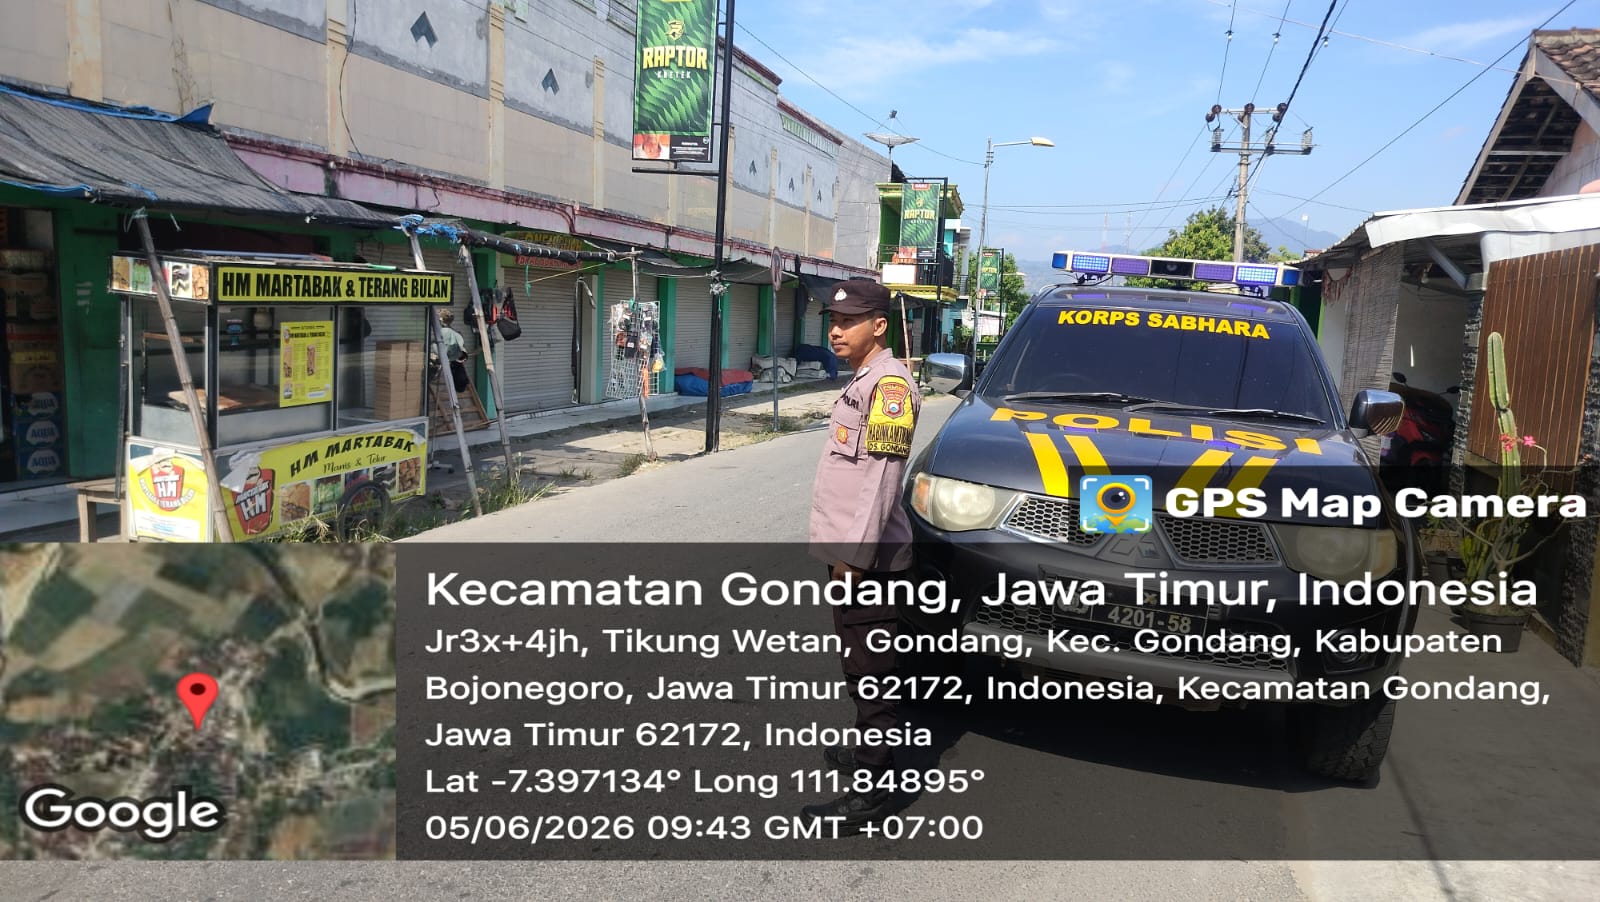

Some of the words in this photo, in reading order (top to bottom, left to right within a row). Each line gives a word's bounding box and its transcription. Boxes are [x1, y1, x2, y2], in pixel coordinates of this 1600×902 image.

[642, 45, 708, 71] RAPTOR
[222, 271, 251, 297] HM
[256, 273, 342, 298] MARTABAK
[345, 279, 356, 297] &
[359, 276, 408, 298] TERANG
[411, 278, 449, 299] BULAN
[1057, 309, 1140, 327] KORPS
[1147, 312, 1271, 340] SABHARA
[989, 407, 1324, 456] POLISI
[290, 449, 319, 478] HM
[324, 435, 415, 460] MARTABAK
[355, 457, 363, 467] &
[157, 481, 177, 498] HM
[240, 491, 268, 521] HM
[1107, 605, 1192, 634] 4201-58
